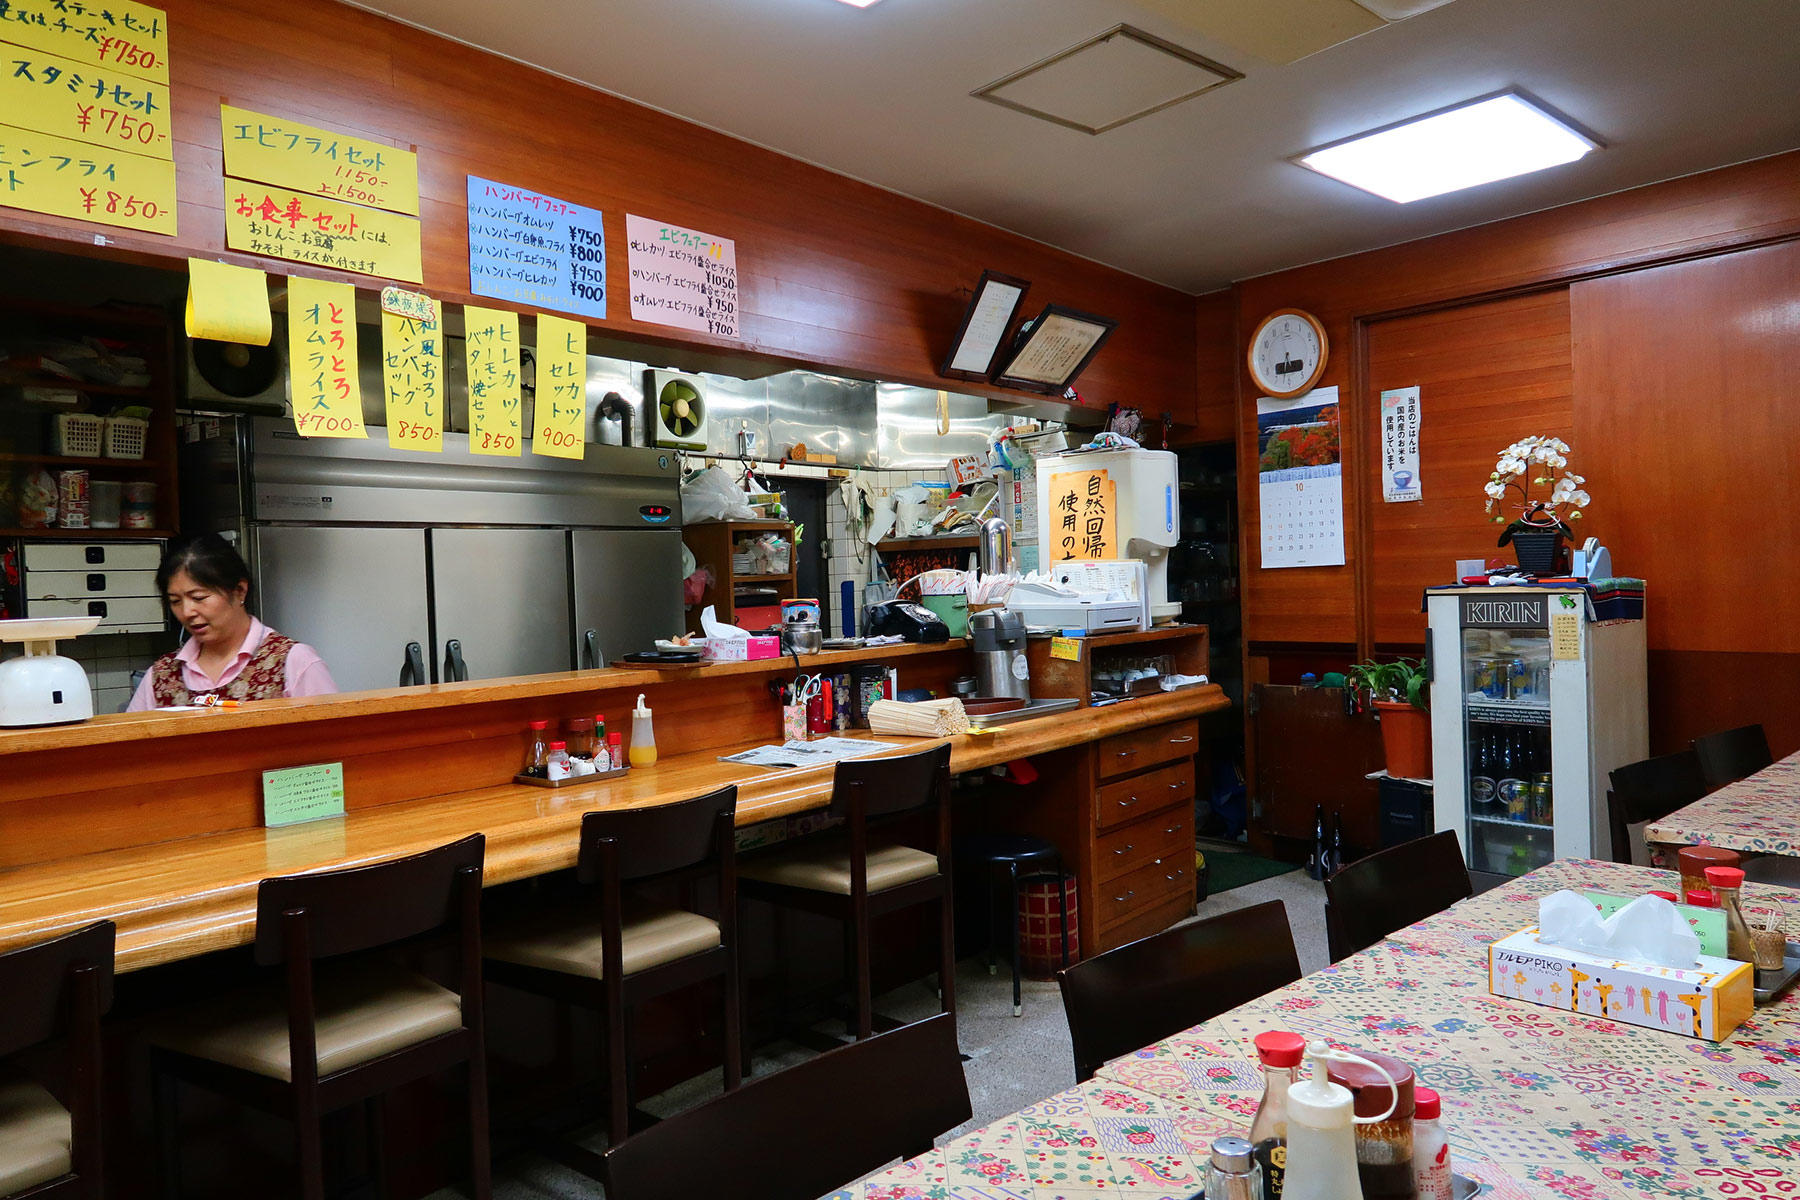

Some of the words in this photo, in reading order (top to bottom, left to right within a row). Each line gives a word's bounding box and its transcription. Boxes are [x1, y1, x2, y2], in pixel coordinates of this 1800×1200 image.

[11, 60, 160, 114] スタミナセット
[234, 124, 386, 171] エビフライセット
[569, 226, 602, 247] ¥750
[569, 243, 603, 264] ¥800
[570, 262, 602, 283] ¥950
[570, 281, 603, 302] ¥900
[304, 304, 330, 410] オムライス
[328, 302, 350, 399] とろとろ
[399, 319, 421, 405] ハンバーグ
[481, 326, 497, 389] サーモン
[386, 352, 400, 403] セット
[550, 364, 563, 418] セット
[566, 333, 581, 425] ヒレカツ
[482, 432, 515, 450] 850
[1295, 482, 1304, 492] 10
[1082, 475, 1106, 559] 自然回帰
[1467, 602, 1540, 623] KIRIN
